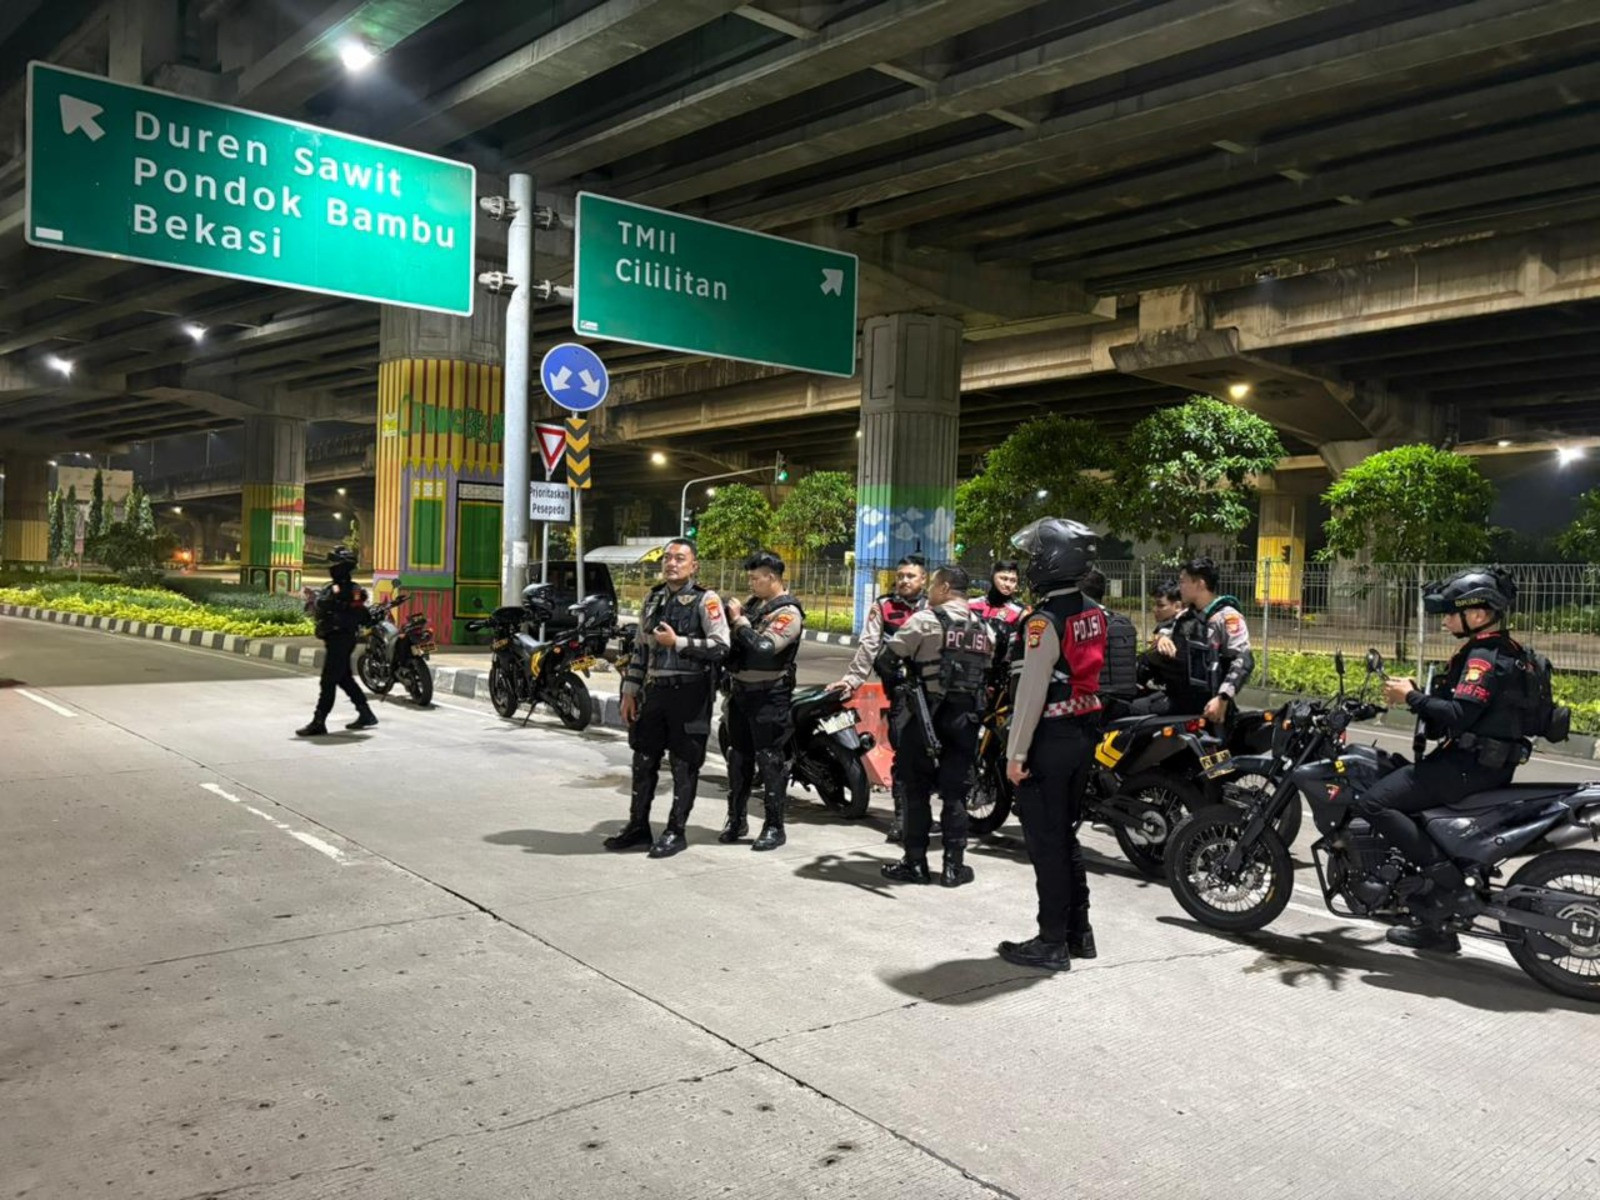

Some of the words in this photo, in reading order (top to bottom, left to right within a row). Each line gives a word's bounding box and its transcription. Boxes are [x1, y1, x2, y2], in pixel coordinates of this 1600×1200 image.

[135, 110, 267, 166] Duren
[294, 147, 402, 197] Sawit
[134, 157, 302, 218] Pondok
[327, 197, 454, 249] Bambu
[134, 204, 281, 258] Bekasi
[618, 220, 675, 254] TMII
[615, 258, 727, 301] Cililitan
[532, 502, 566, 516] Pesepeda
